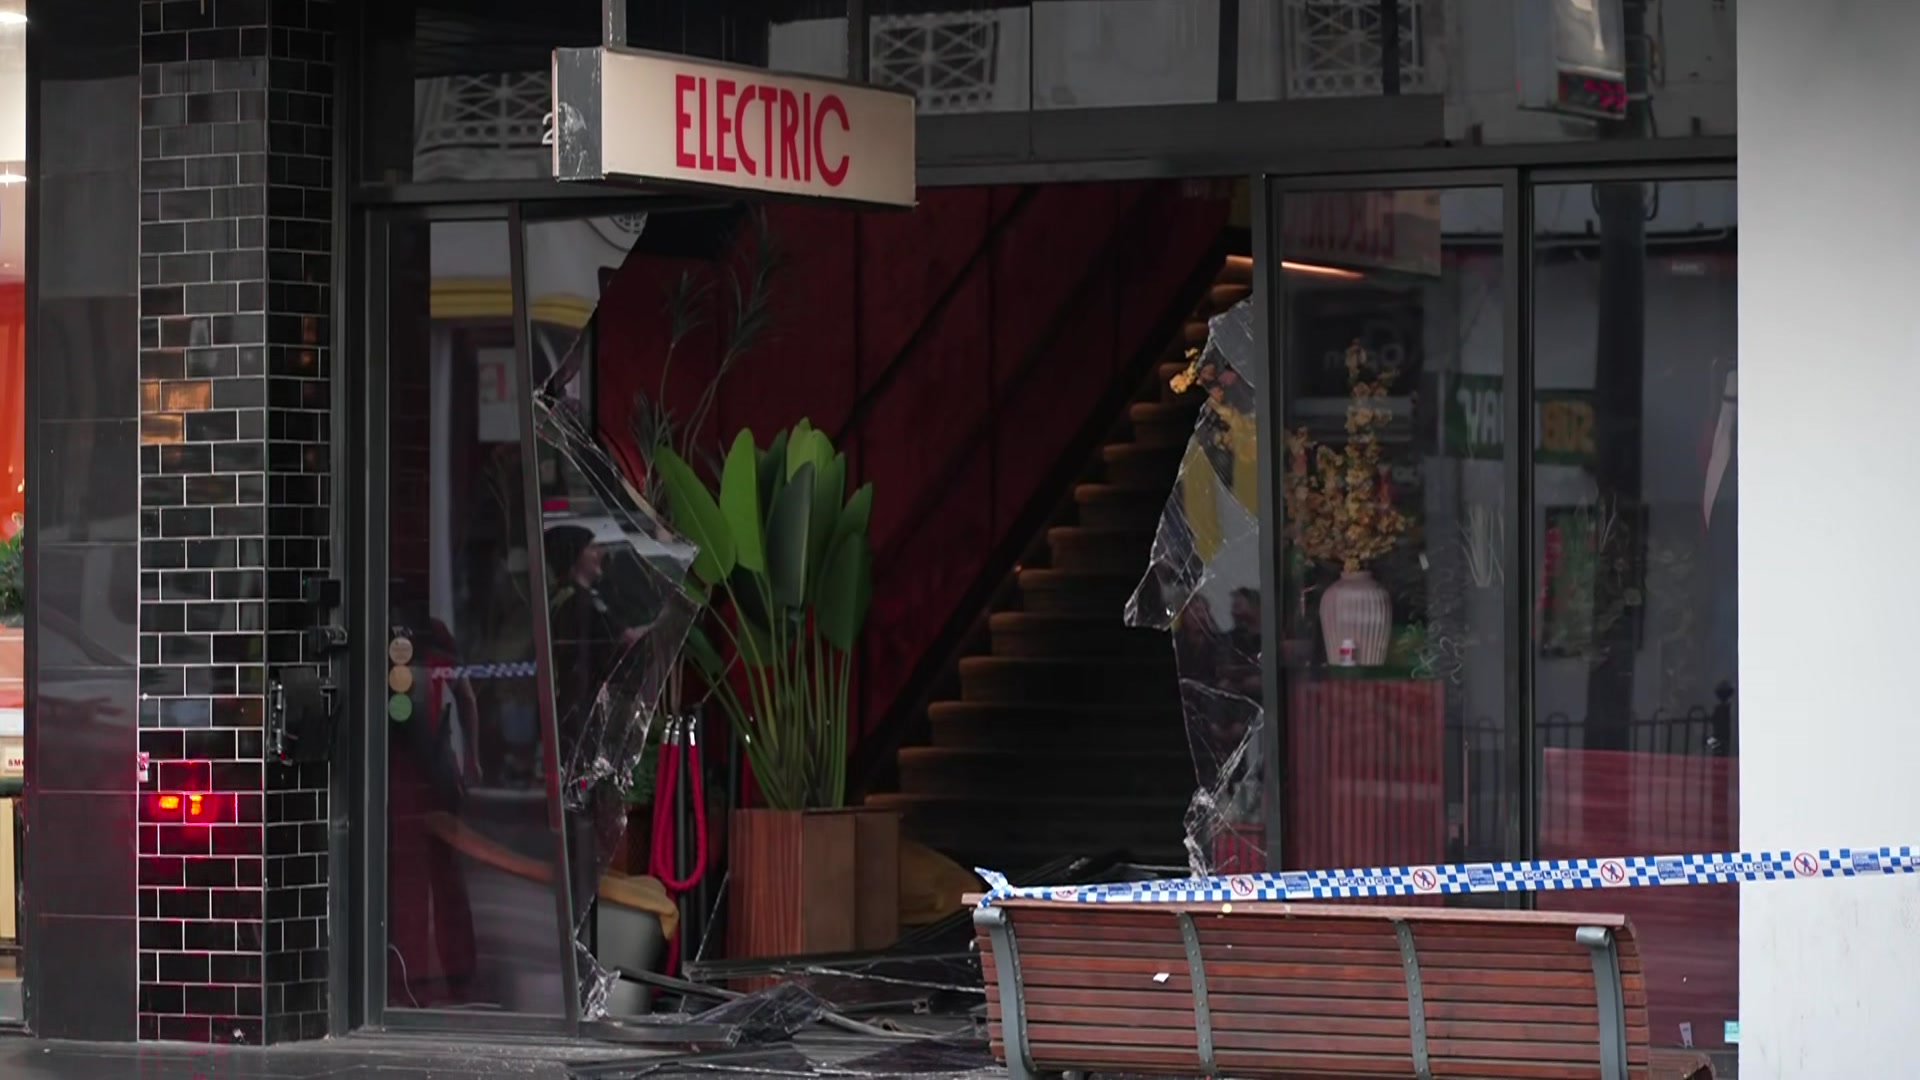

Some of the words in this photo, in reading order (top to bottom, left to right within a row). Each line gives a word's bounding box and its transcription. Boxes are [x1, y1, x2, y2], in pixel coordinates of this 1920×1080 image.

[675, 74, 850, 187] ELECTRIC
[1714, 862, 1771, 873] POLICE
[1523, 870, 1579, 880] POLICE
[1159, 880, 1212, 891] POLICE
[1338, 876, 1392, 887] POLICE
